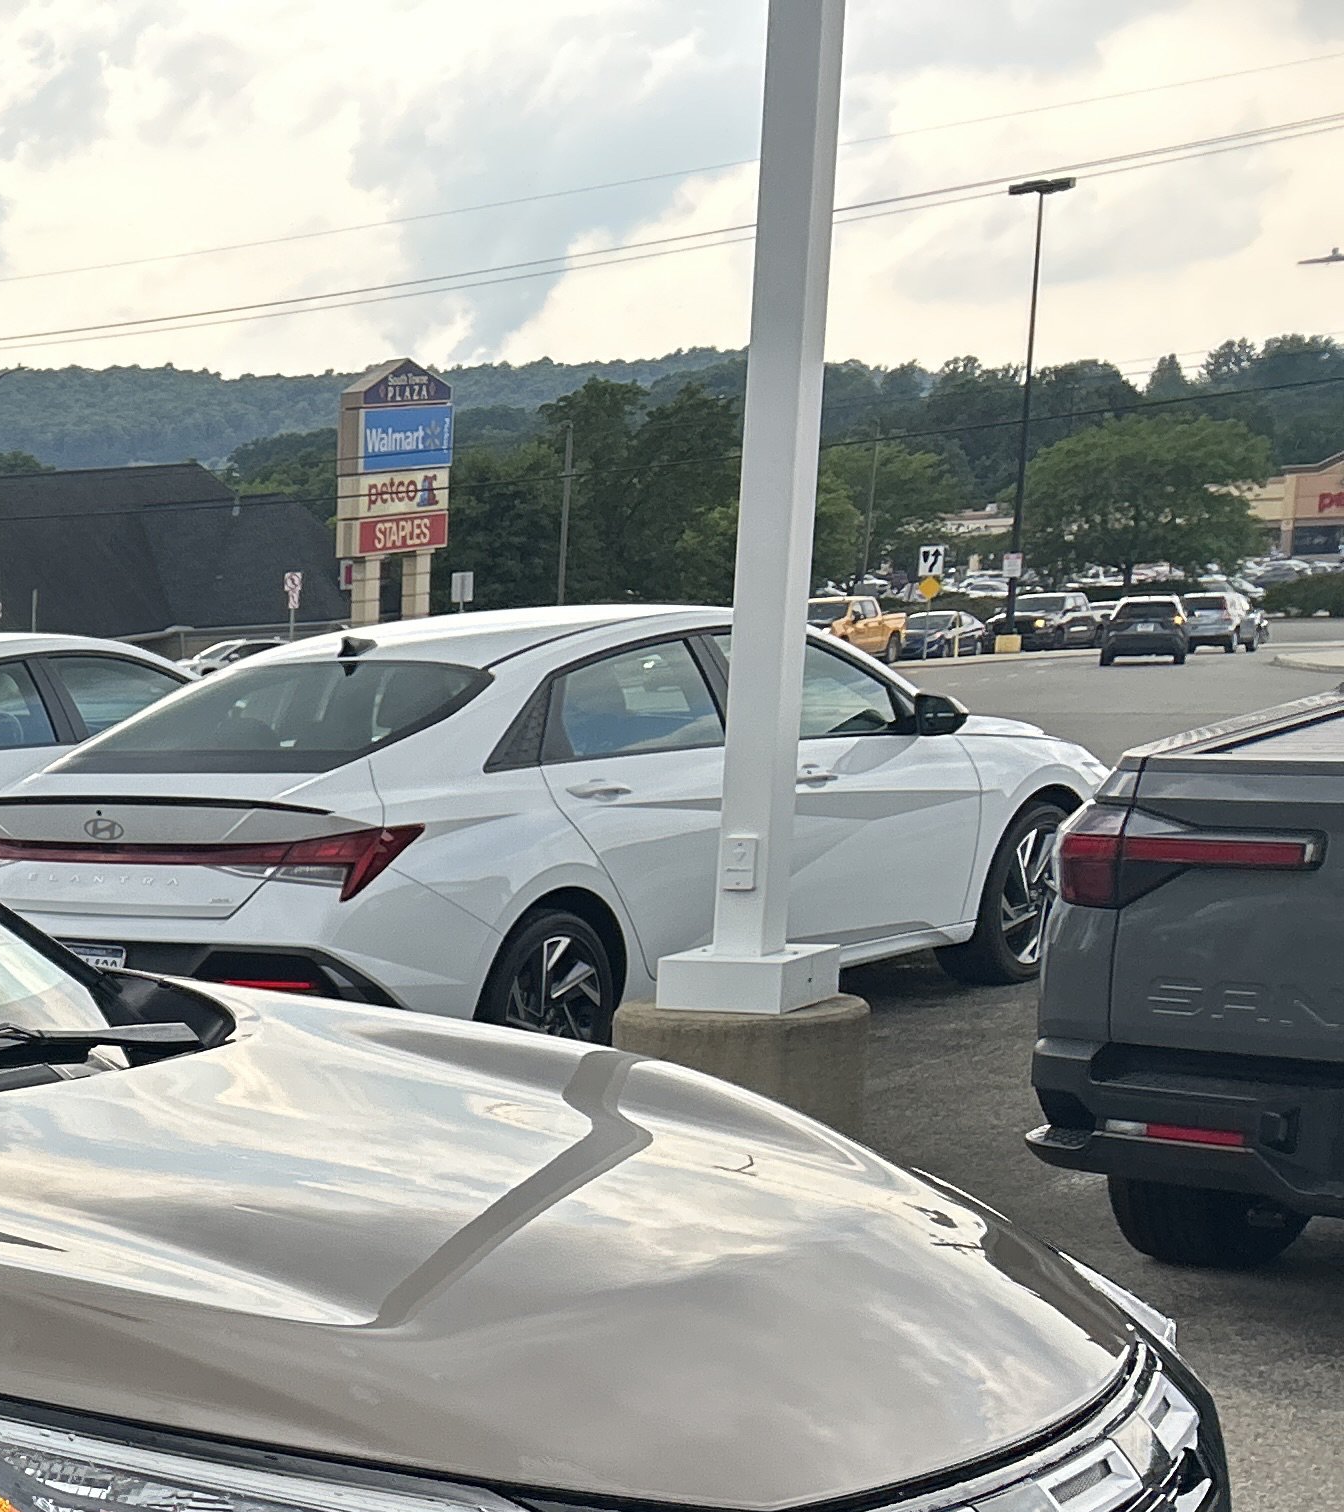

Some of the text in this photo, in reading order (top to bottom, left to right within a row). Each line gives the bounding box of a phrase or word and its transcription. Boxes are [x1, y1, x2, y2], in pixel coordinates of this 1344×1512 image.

[387, 384, 429, 401] PLAZA
[366, 426, 425, 453] Walmart
[367, 477, 418, 512] petco
[374, 518, 430, 549] STAPLES
[28, 871, 180, 886] ELANTRA
